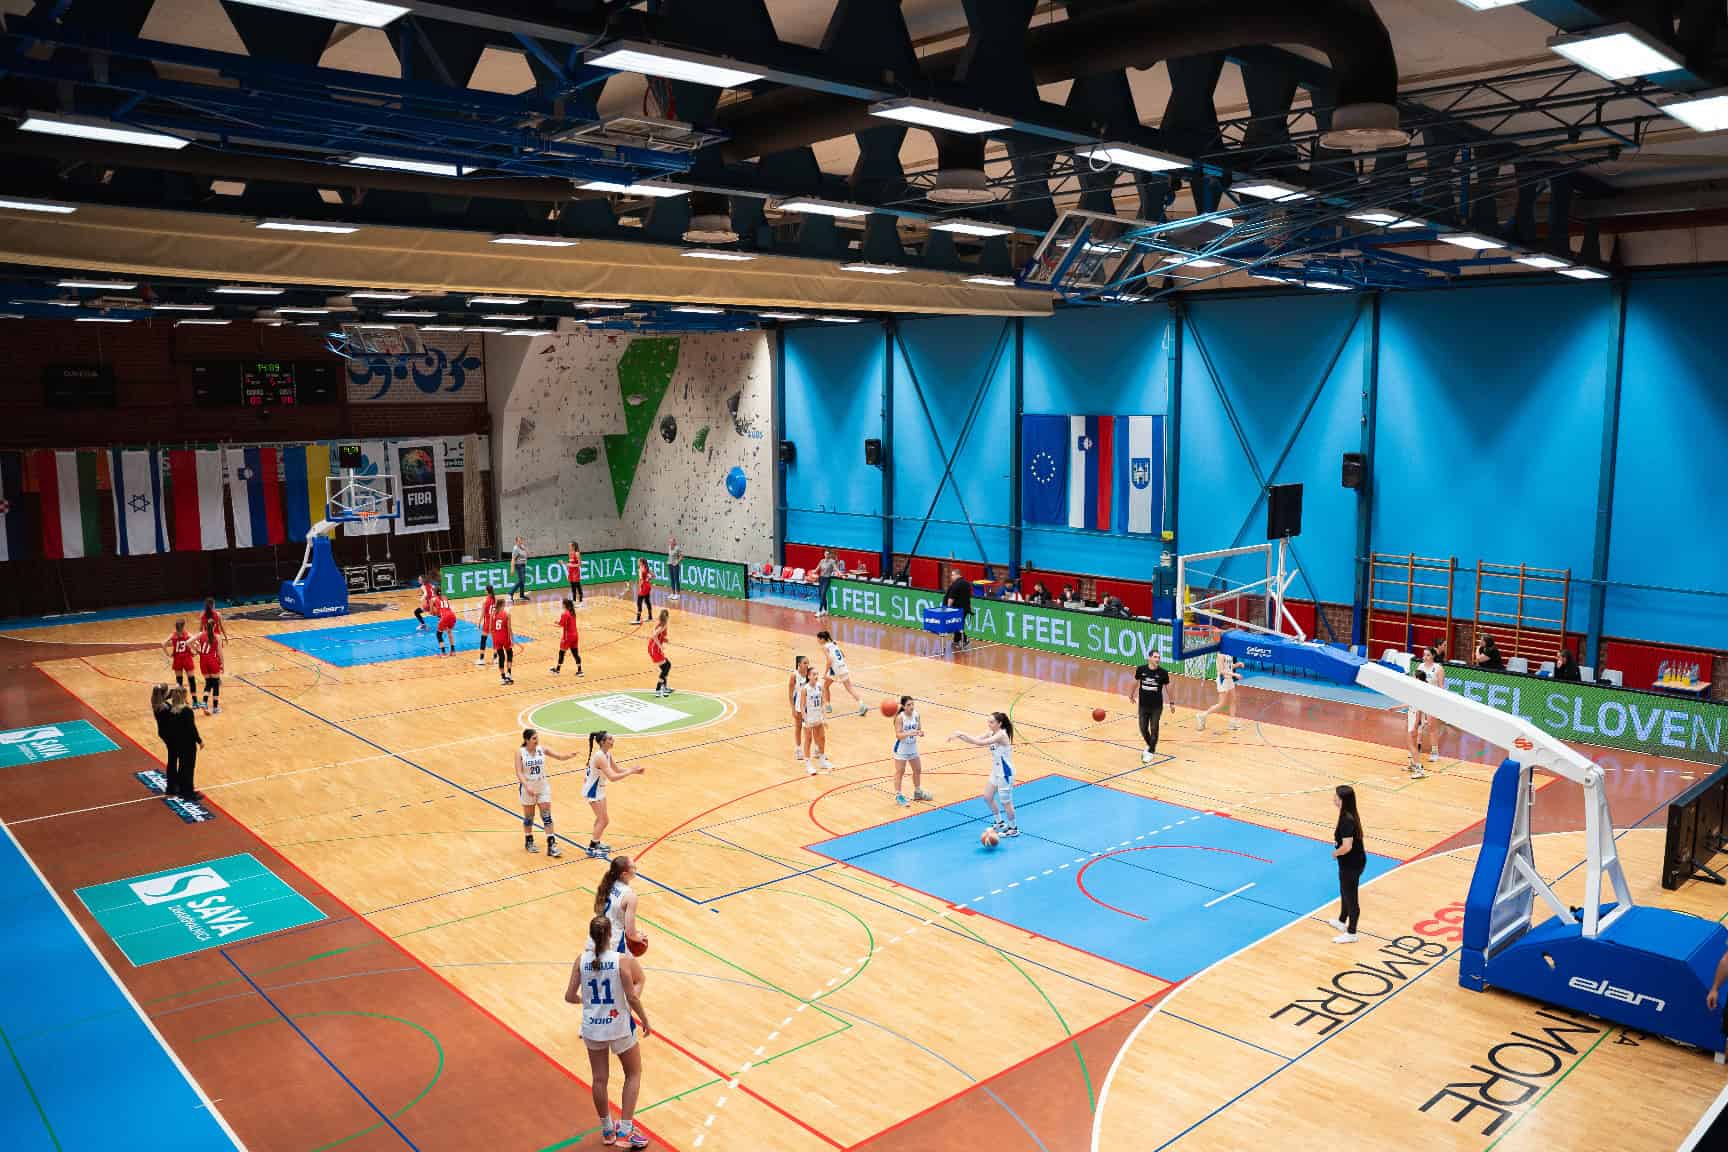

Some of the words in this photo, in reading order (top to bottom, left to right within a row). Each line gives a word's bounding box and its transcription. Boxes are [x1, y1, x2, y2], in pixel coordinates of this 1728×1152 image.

[408, 491, 432, 506] FIBA
[444, 573, 455, 594] I
[461, 567, 516, 593] FEEL
[679, 563, 742, 593] LOVENIA
[830, 586, 838, 609] I
[842, 587, 887, 617] FEEL
[891, 594, 997, 635] SLOIA
[1005, 611, 1016, 638] I
[1022, 613, 1080, 649] FEEL
[1087, 624, 1175, 664] SLOVE
[1544, 692, 1723, 753] SLOVEN
[187, 895, 255, 937] SAVA
[587, 978, 615, 1004] 11
[1568, 975, 1666, 1013] elan
